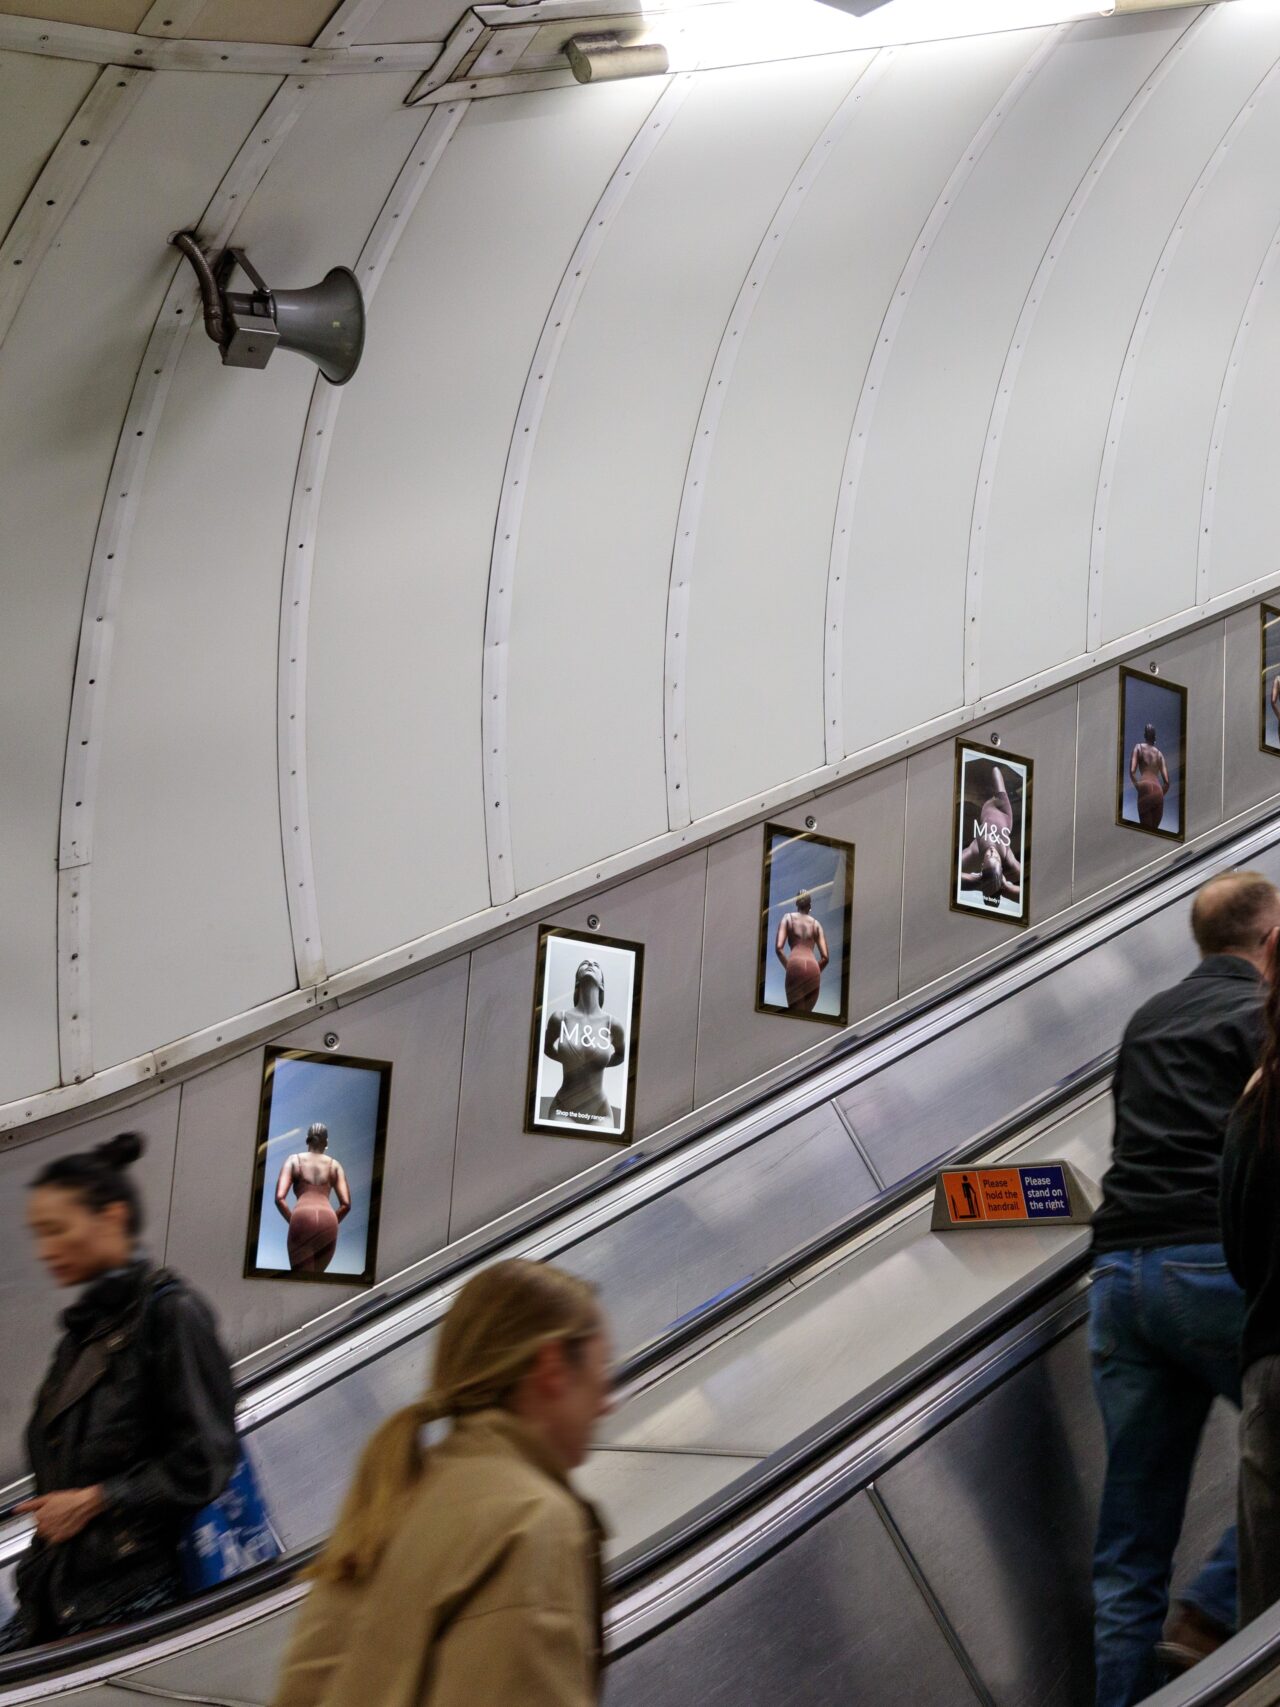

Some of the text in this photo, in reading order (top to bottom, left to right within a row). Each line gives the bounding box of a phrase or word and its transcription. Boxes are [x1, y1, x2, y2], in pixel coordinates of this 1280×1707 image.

[974, 819, 1011, 847] M&S
[559, 1020, 611, 1050] M&S
[555, 1109, 569, 1117] Shop
[578, 1112, 591, 1120] body
[983, 1179, 1009, 1188] Please
[1024, 1176, 1051, 1186] Please
[985, 1190, 1018, 1200] hold the
[1027, 1187, 1063, 1198] stand on
[988, 1202, 1020, 1212] handrail
[1029, 1199, 1066, 1211] the right
